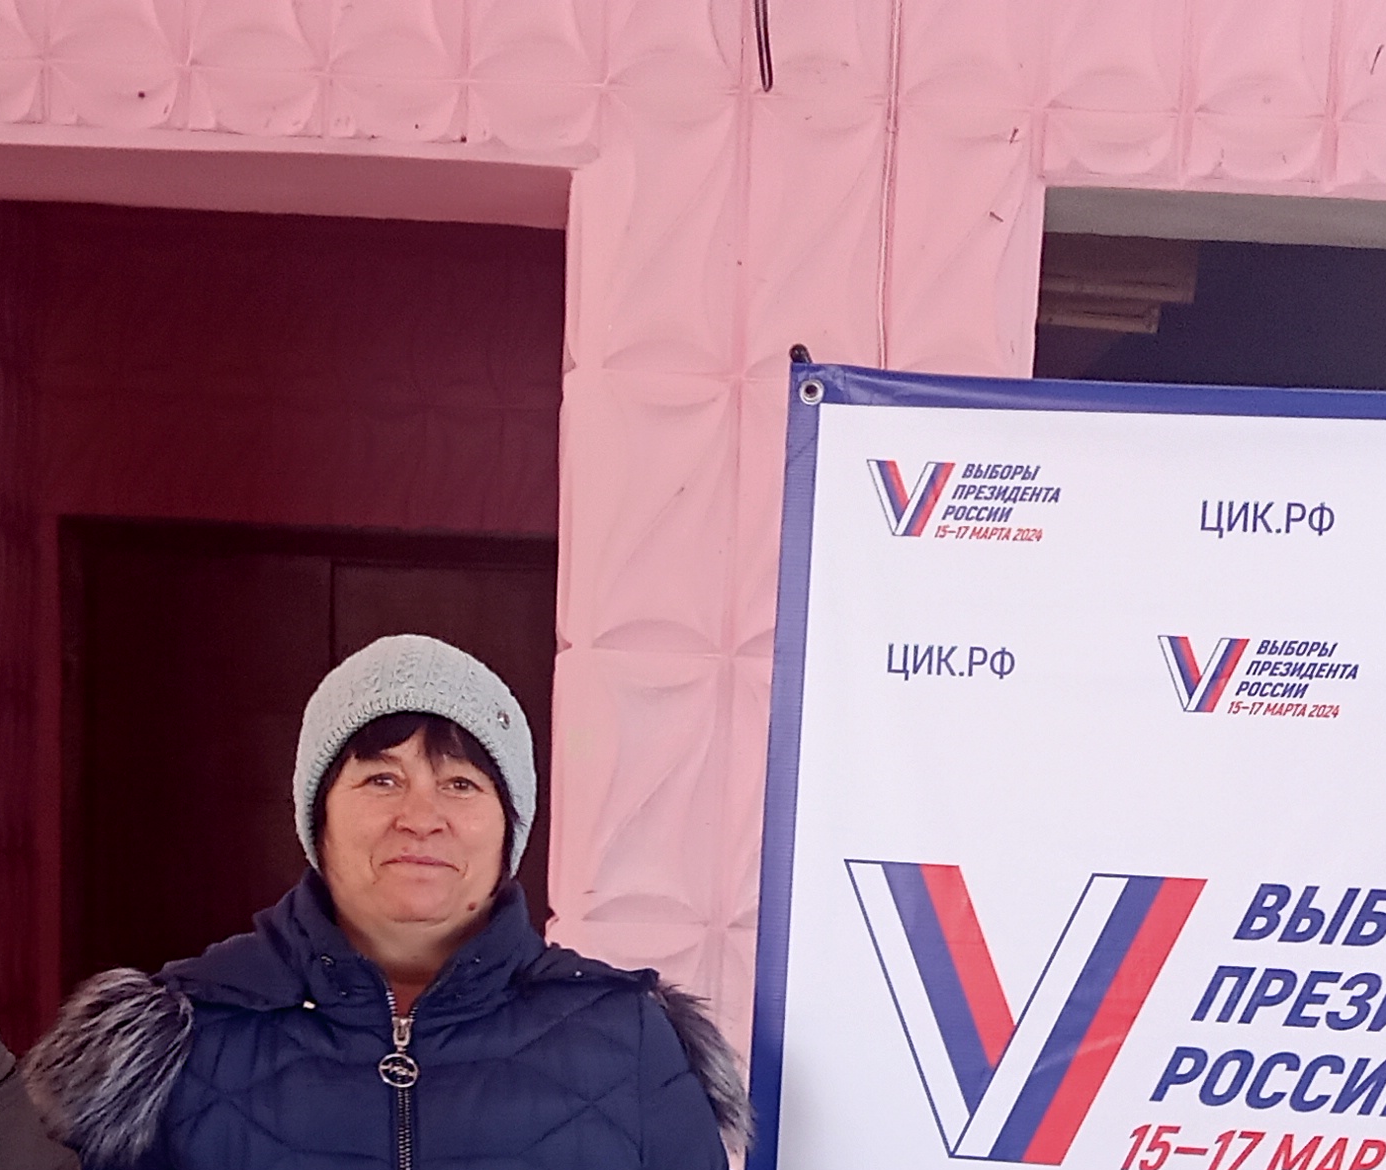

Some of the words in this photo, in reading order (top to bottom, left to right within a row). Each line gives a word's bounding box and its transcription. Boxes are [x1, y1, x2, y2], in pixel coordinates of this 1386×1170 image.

[961, 464, 1041, 480] ВЫБОРЫ
[951, 485, 1062, 503] ПРЕЗИДЕНТА
[941, 506, 1013, 522] РОССИИ
[1200, 500, 1335, 539] ЦИК.РФ
[968, 527, 1011, 541] МАРТА
[1012, 529, 1043, 542] 2024
[1255, 640, 1338, 656] ВЫБОРЫ
[886, 643, 1016, 682] ЦИК.РФ
[1245, 661, 1360, 679] ПРЕЗИДЕНТА
[1235, 682, 1309, 698] РОССИИ
[1262, 703, 1307, 717] МАРТА
[1307, 705, 1340, 718] 2024
